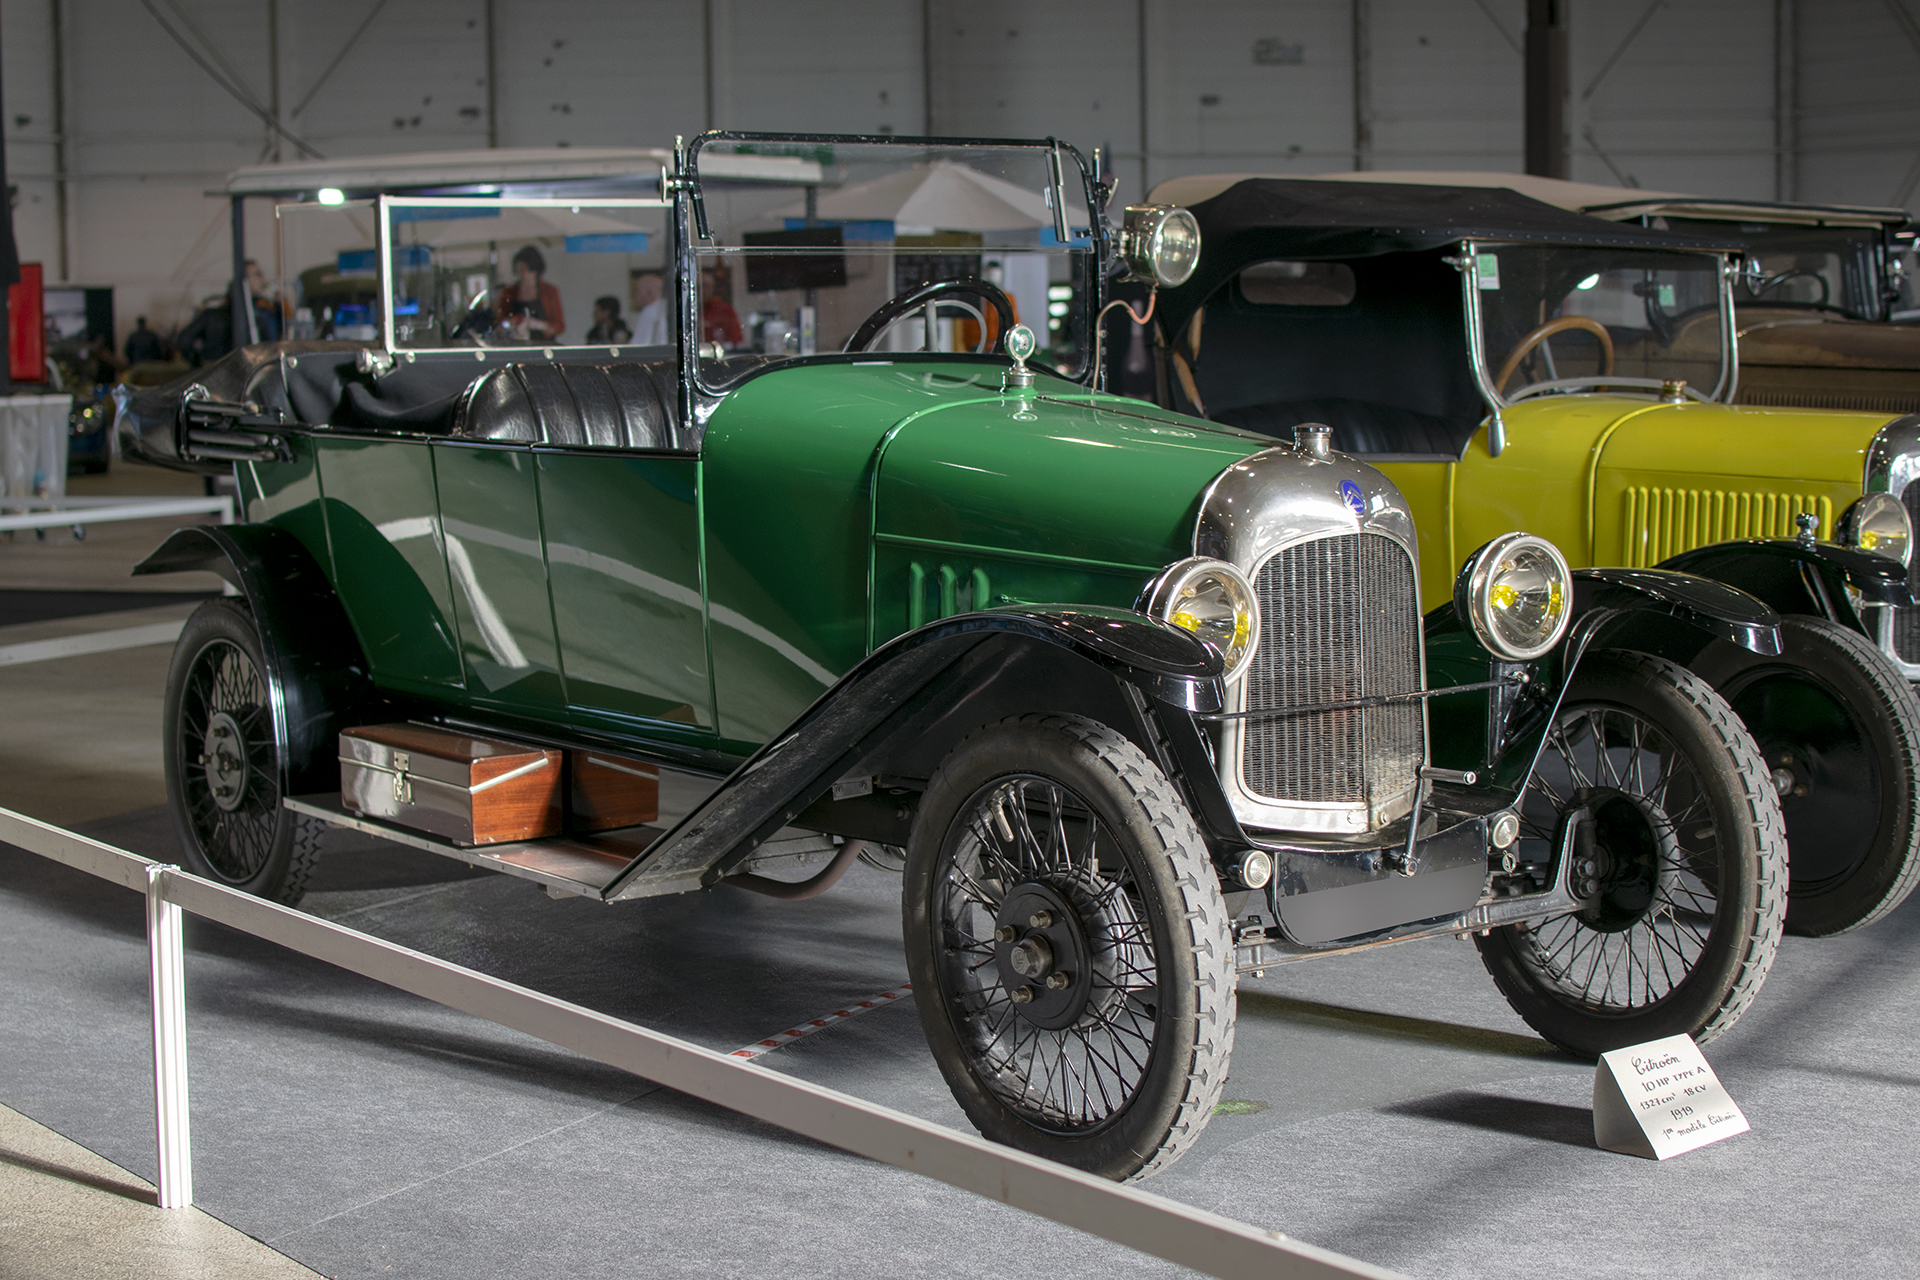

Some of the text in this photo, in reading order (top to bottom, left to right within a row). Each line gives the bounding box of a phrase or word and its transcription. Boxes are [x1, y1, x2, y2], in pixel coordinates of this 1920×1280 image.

[1631, 1053, 1681, 1075] Citroën
[1641, 1066, 1706, 1092] 10 HP TYPE A
[1670, 1106, 1694, 1120] 1919
